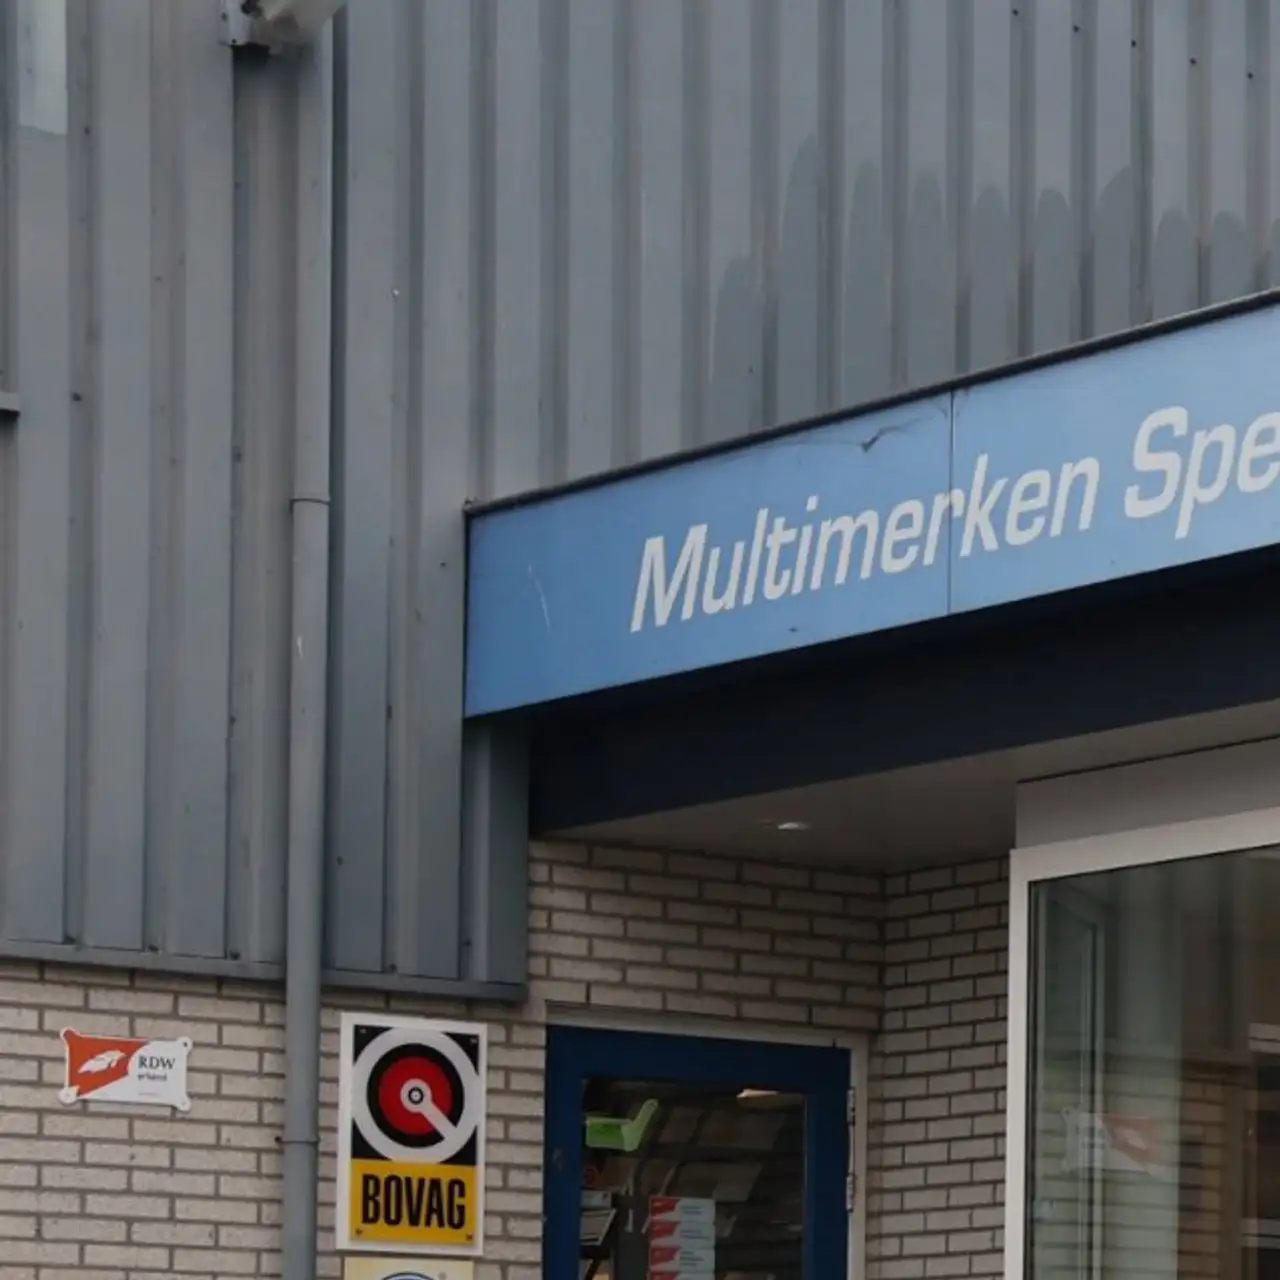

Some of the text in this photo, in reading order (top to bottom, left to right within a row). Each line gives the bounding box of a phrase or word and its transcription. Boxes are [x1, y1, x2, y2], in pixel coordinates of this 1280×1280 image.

[629, 452, 1100, 632] Multimerken
[138, 1055, 176, 1069] RDW
[362, 1173, 466, 1230] BOVAG
